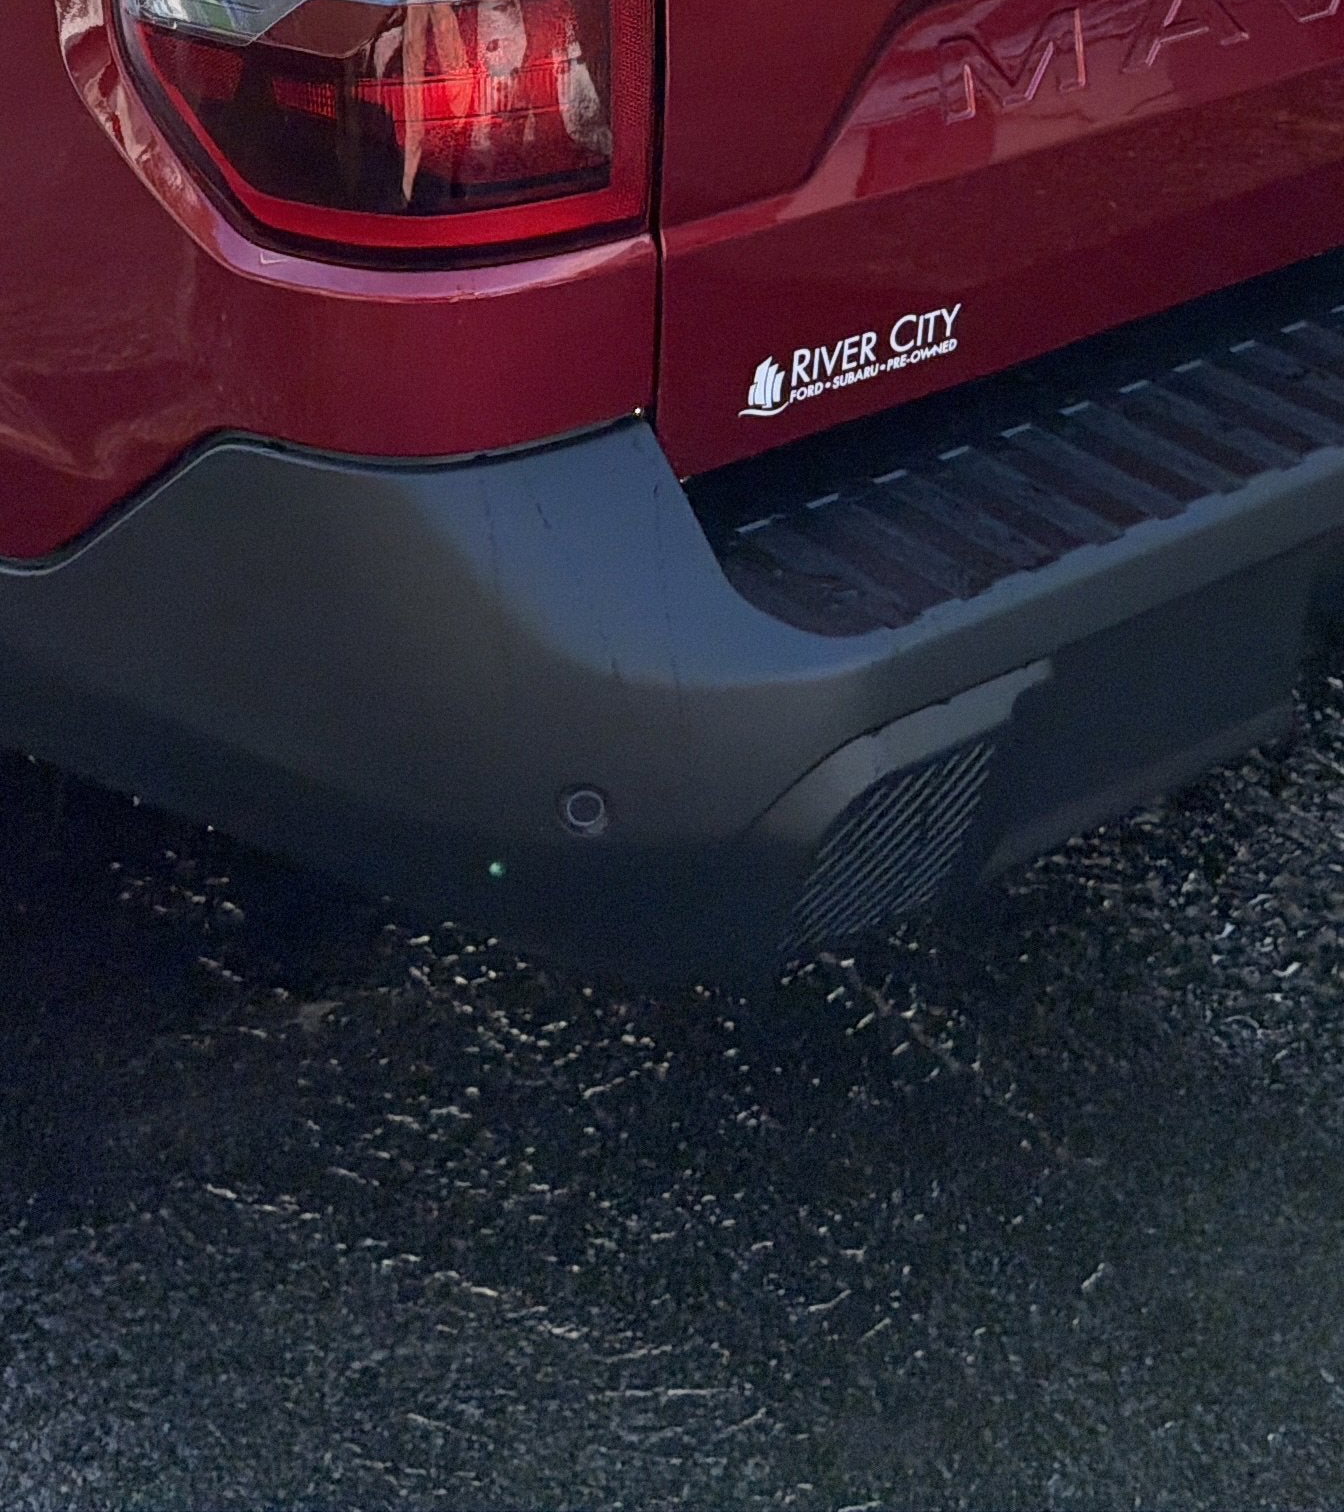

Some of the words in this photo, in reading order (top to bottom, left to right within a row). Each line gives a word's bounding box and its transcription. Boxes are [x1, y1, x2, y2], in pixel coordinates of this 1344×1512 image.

[789, 382, 824, 403] FORD
[831, 362, 880, 389] SUBARU
[887, 338, 958, 371] PRE-OWNED
[790, 331, 877, 387] RIVER
[889, 303, 962, 353] CITY
